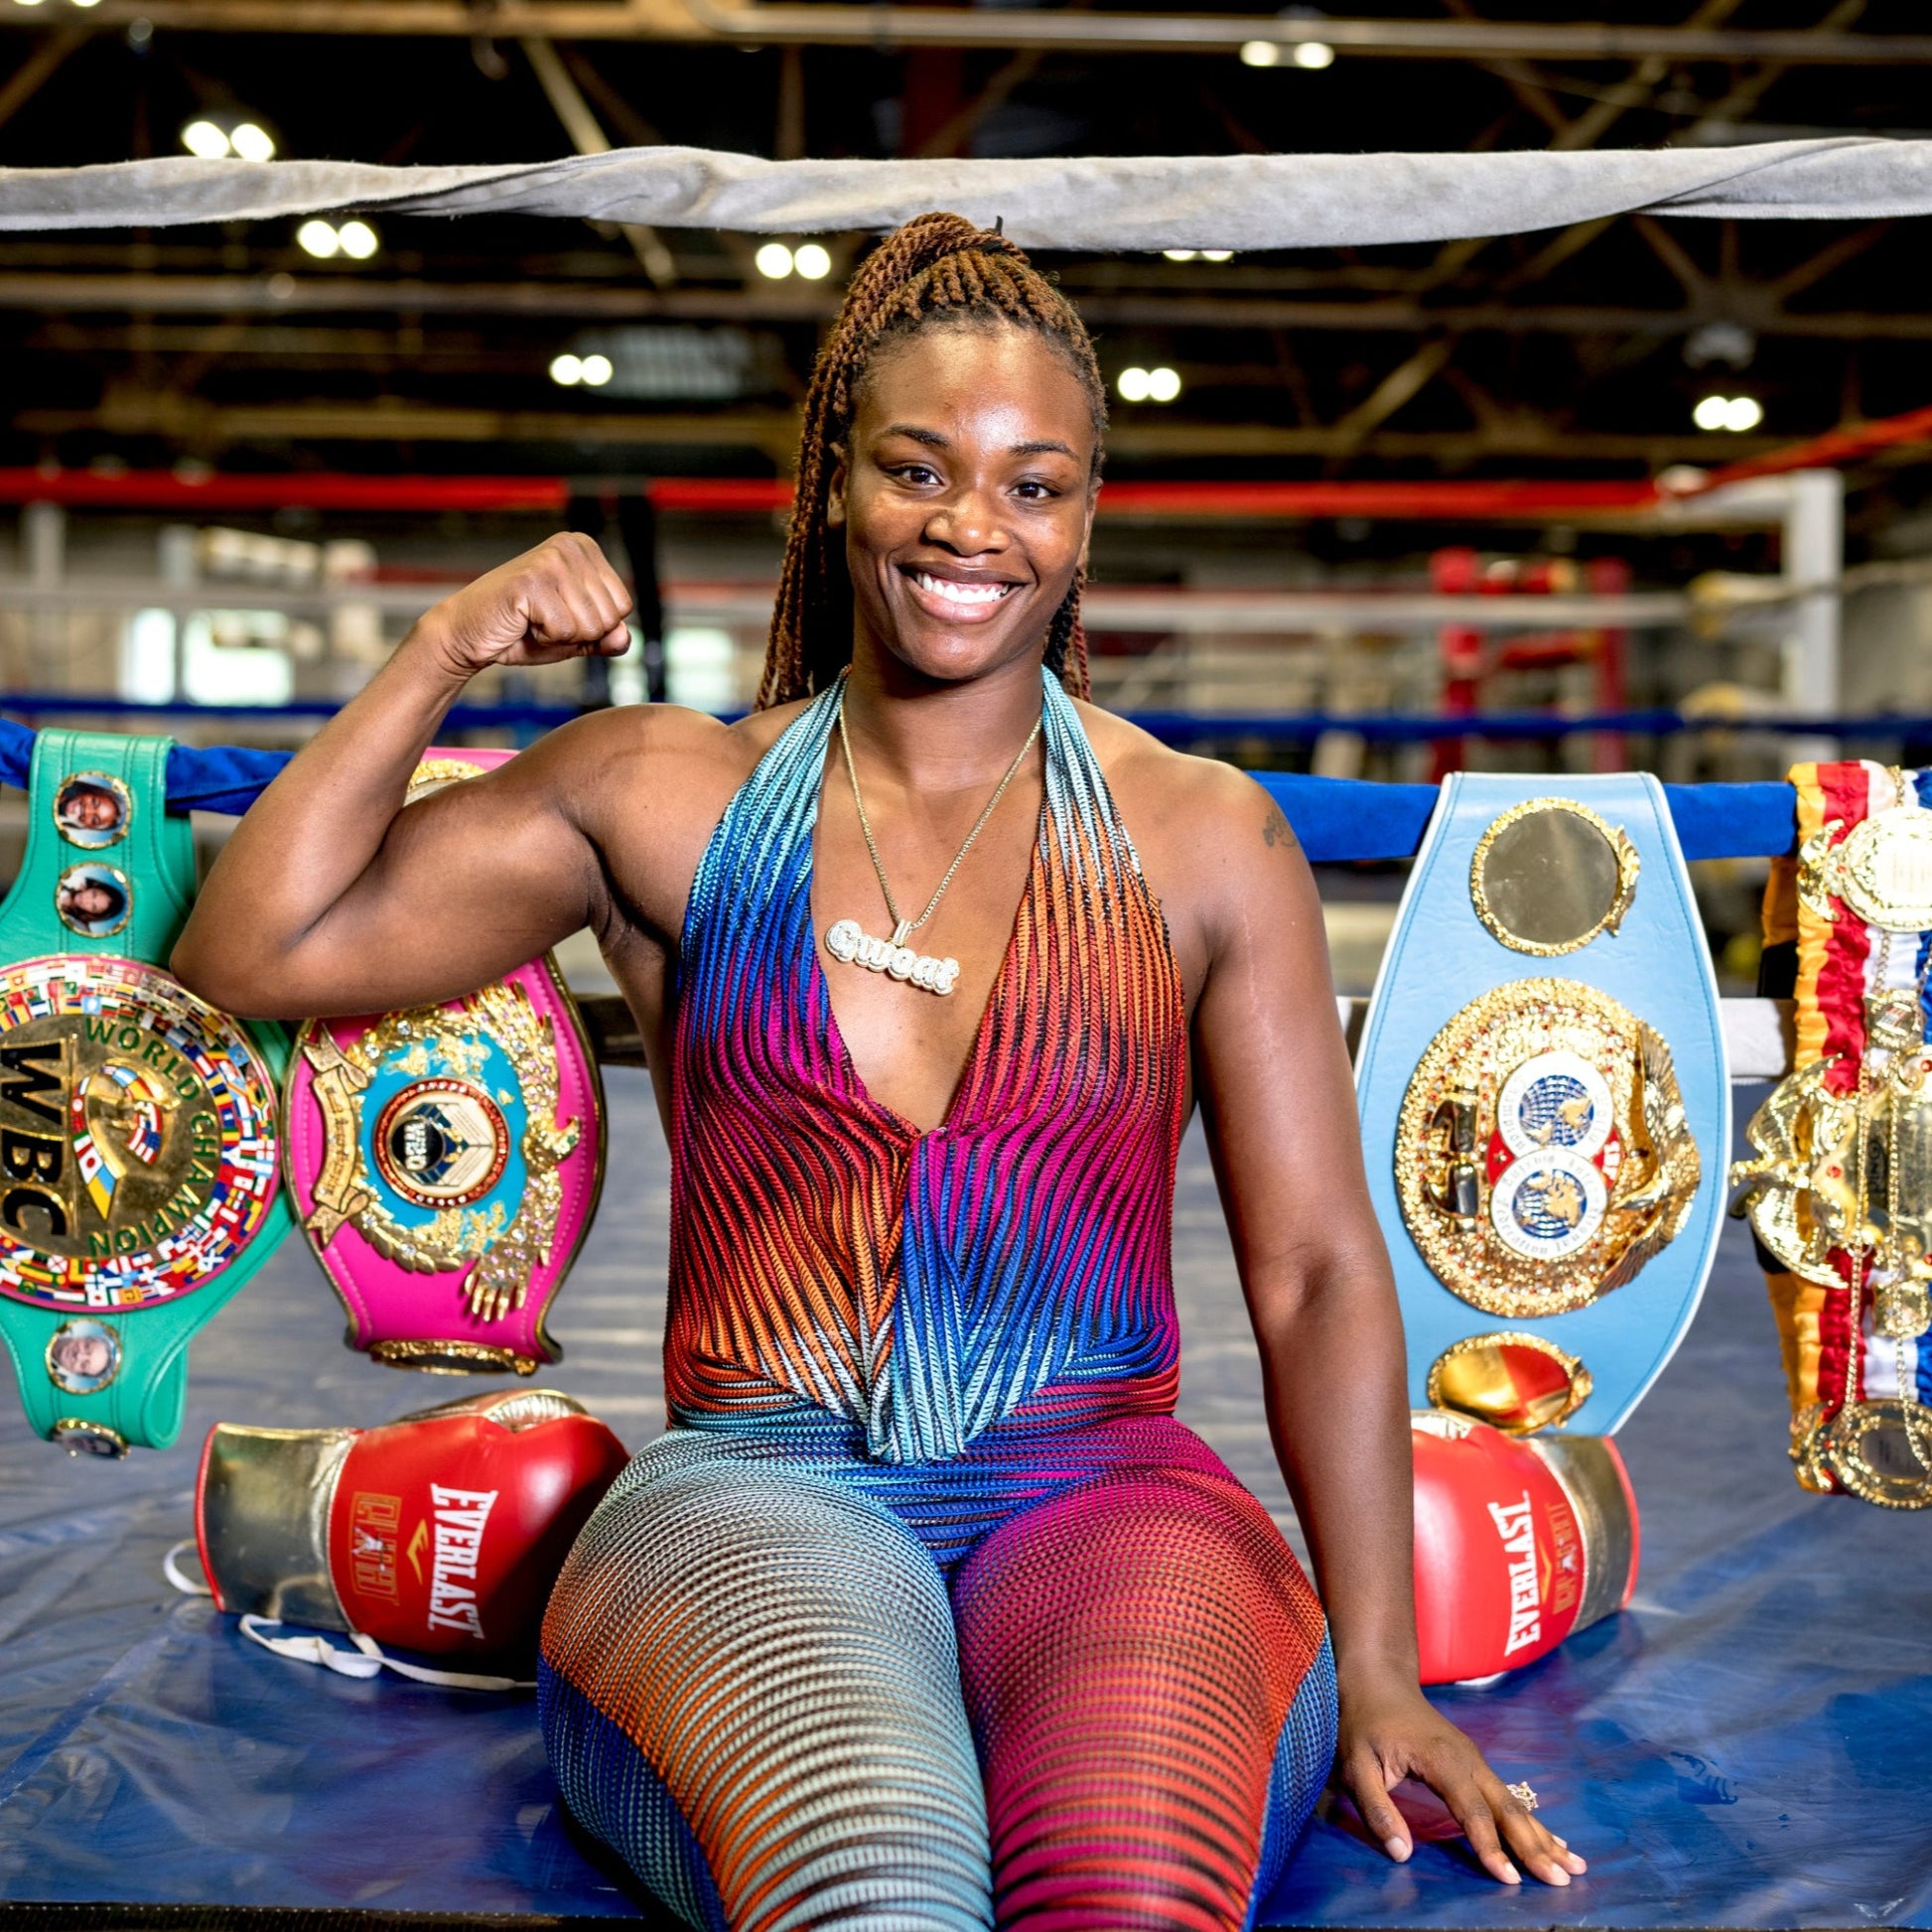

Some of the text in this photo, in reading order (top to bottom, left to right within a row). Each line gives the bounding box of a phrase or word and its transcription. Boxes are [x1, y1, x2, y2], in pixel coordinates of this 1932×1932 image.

[0, 1039, 67, 1236] WBC
[85, 1016, 217, 1256] WORLD CHAMPION
[427, 1482, 499, 1639] EVERLAST
[1486, 1490, 1541, 1657] EVERLAST
